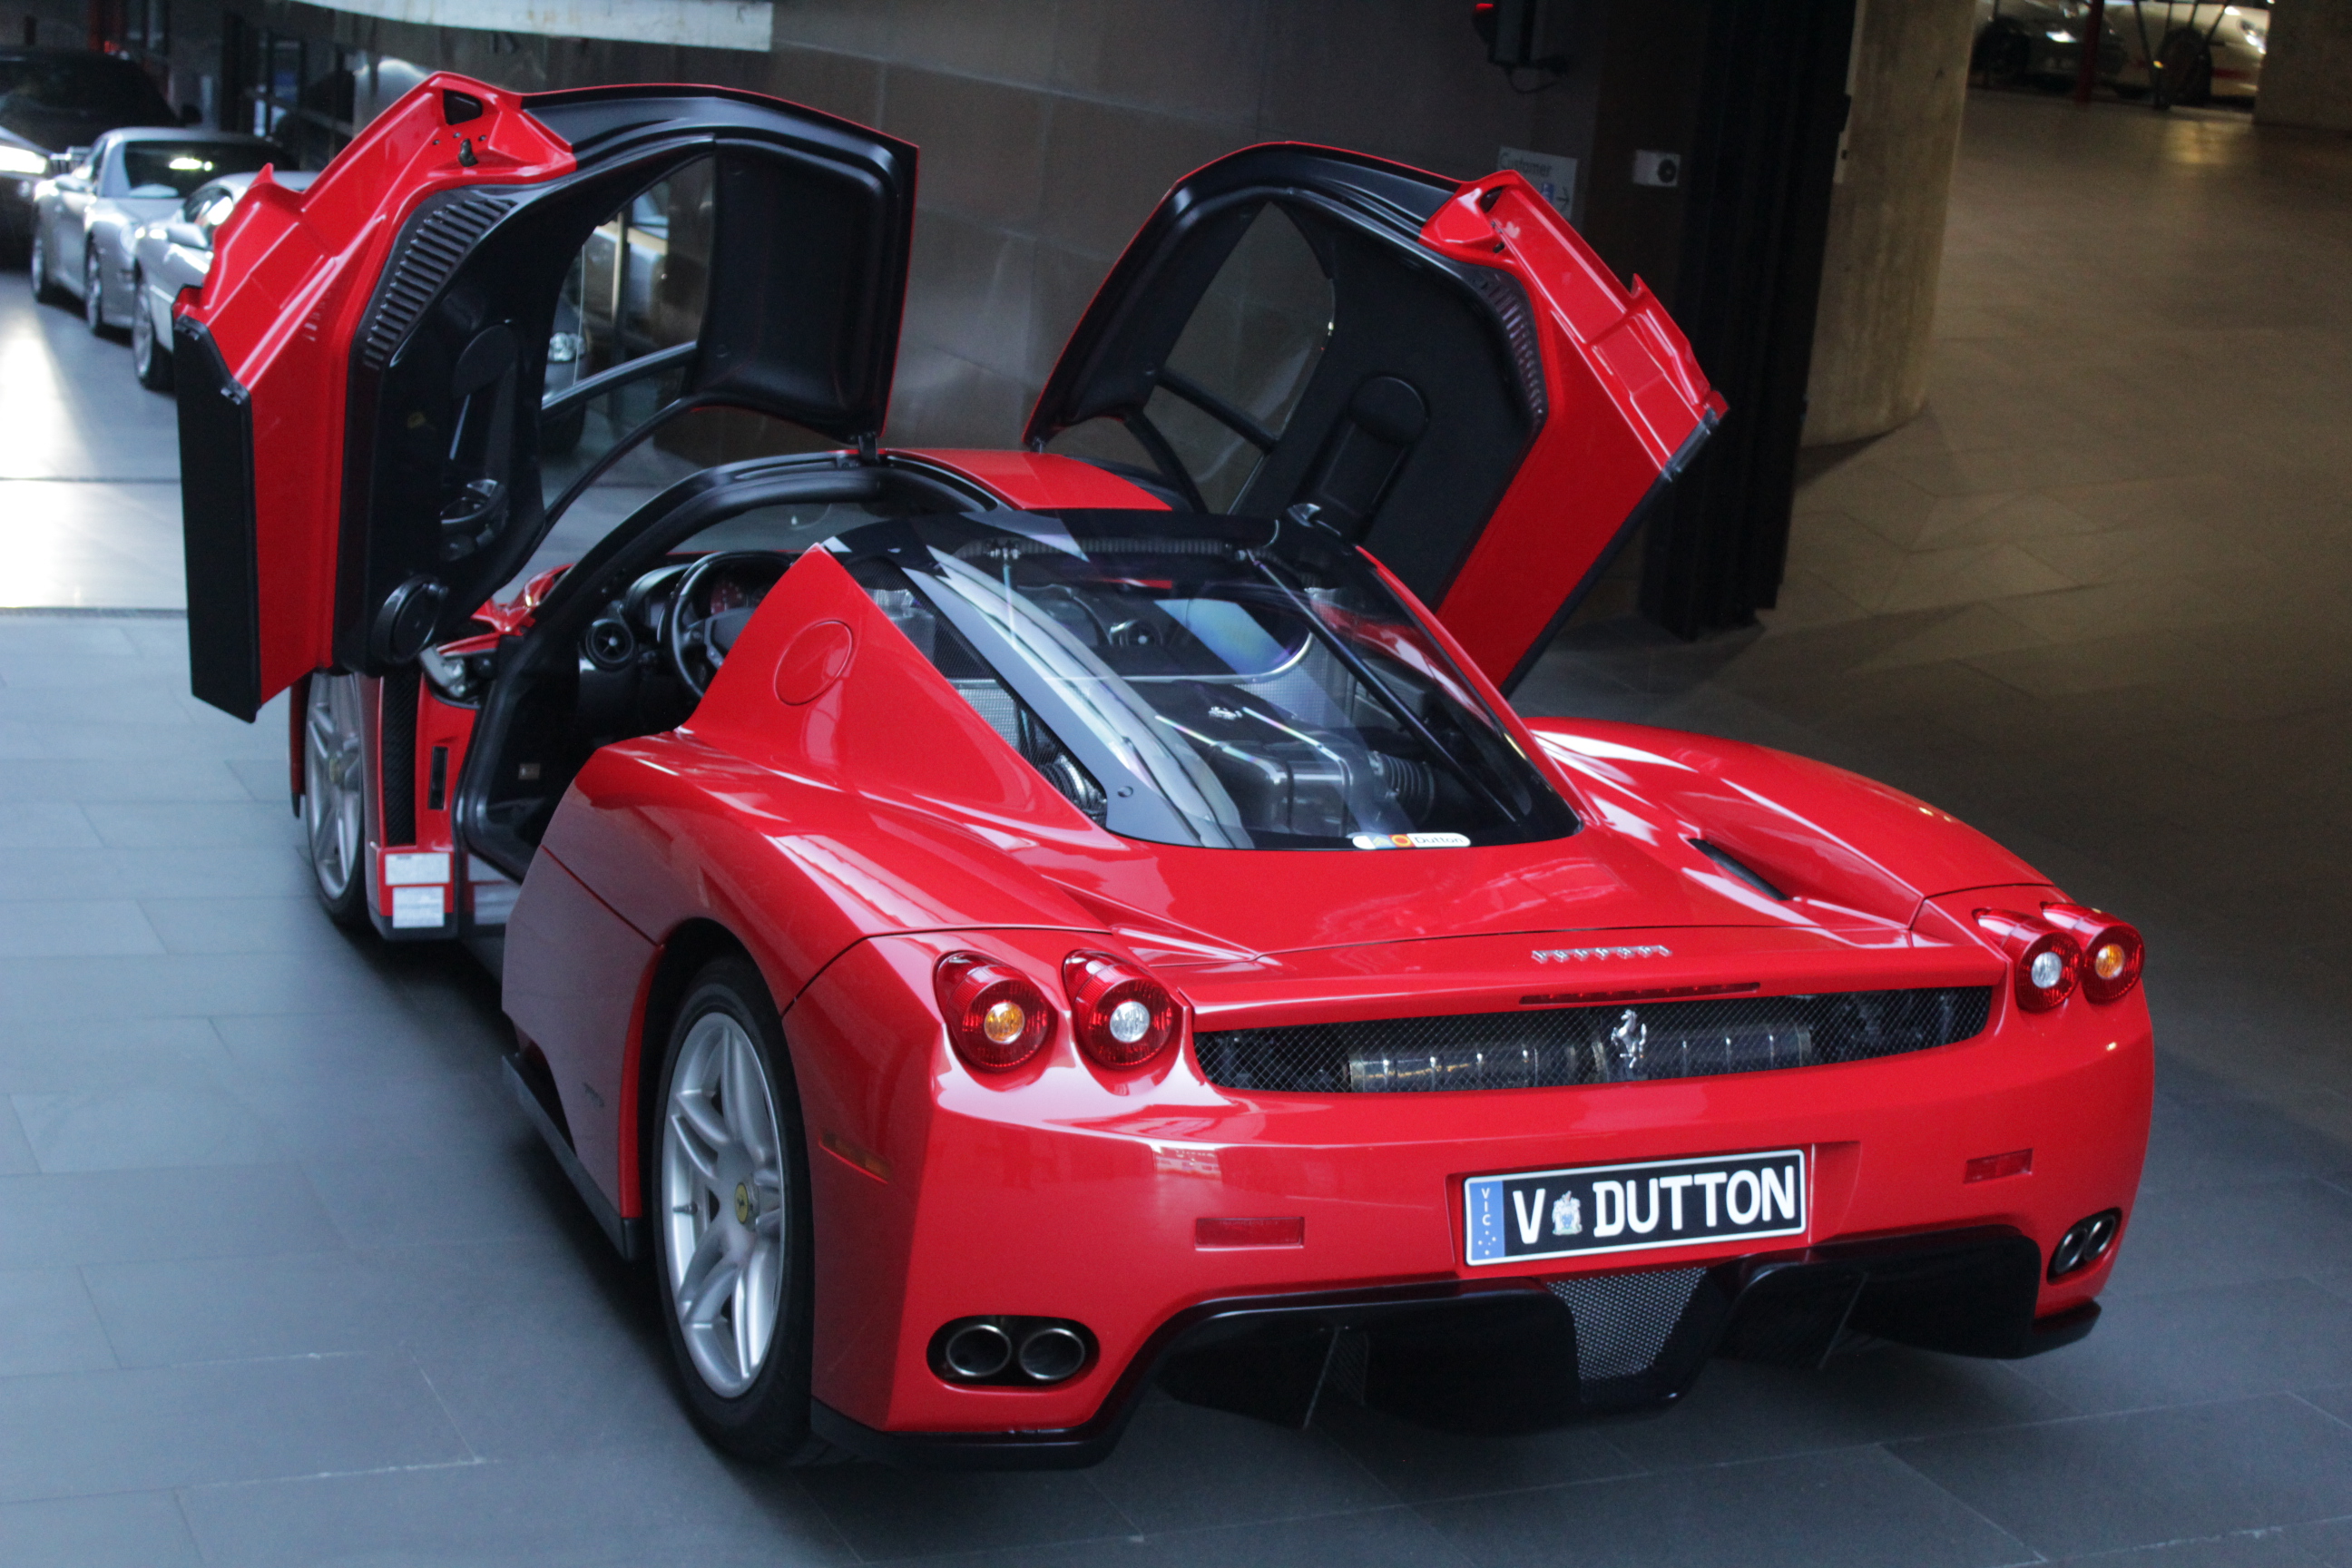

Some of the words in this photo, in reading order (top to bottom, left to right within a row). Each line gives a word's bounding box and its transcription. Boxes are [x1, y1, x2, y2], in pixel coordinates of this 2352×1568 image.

[1415, 836, 1464, 845] Dutton
[1480, 1188, 1492, 1227] VIC
[1513, 1188, 1546, 1244] V
[1592, 1165, 1795, 1237] DUTTON
